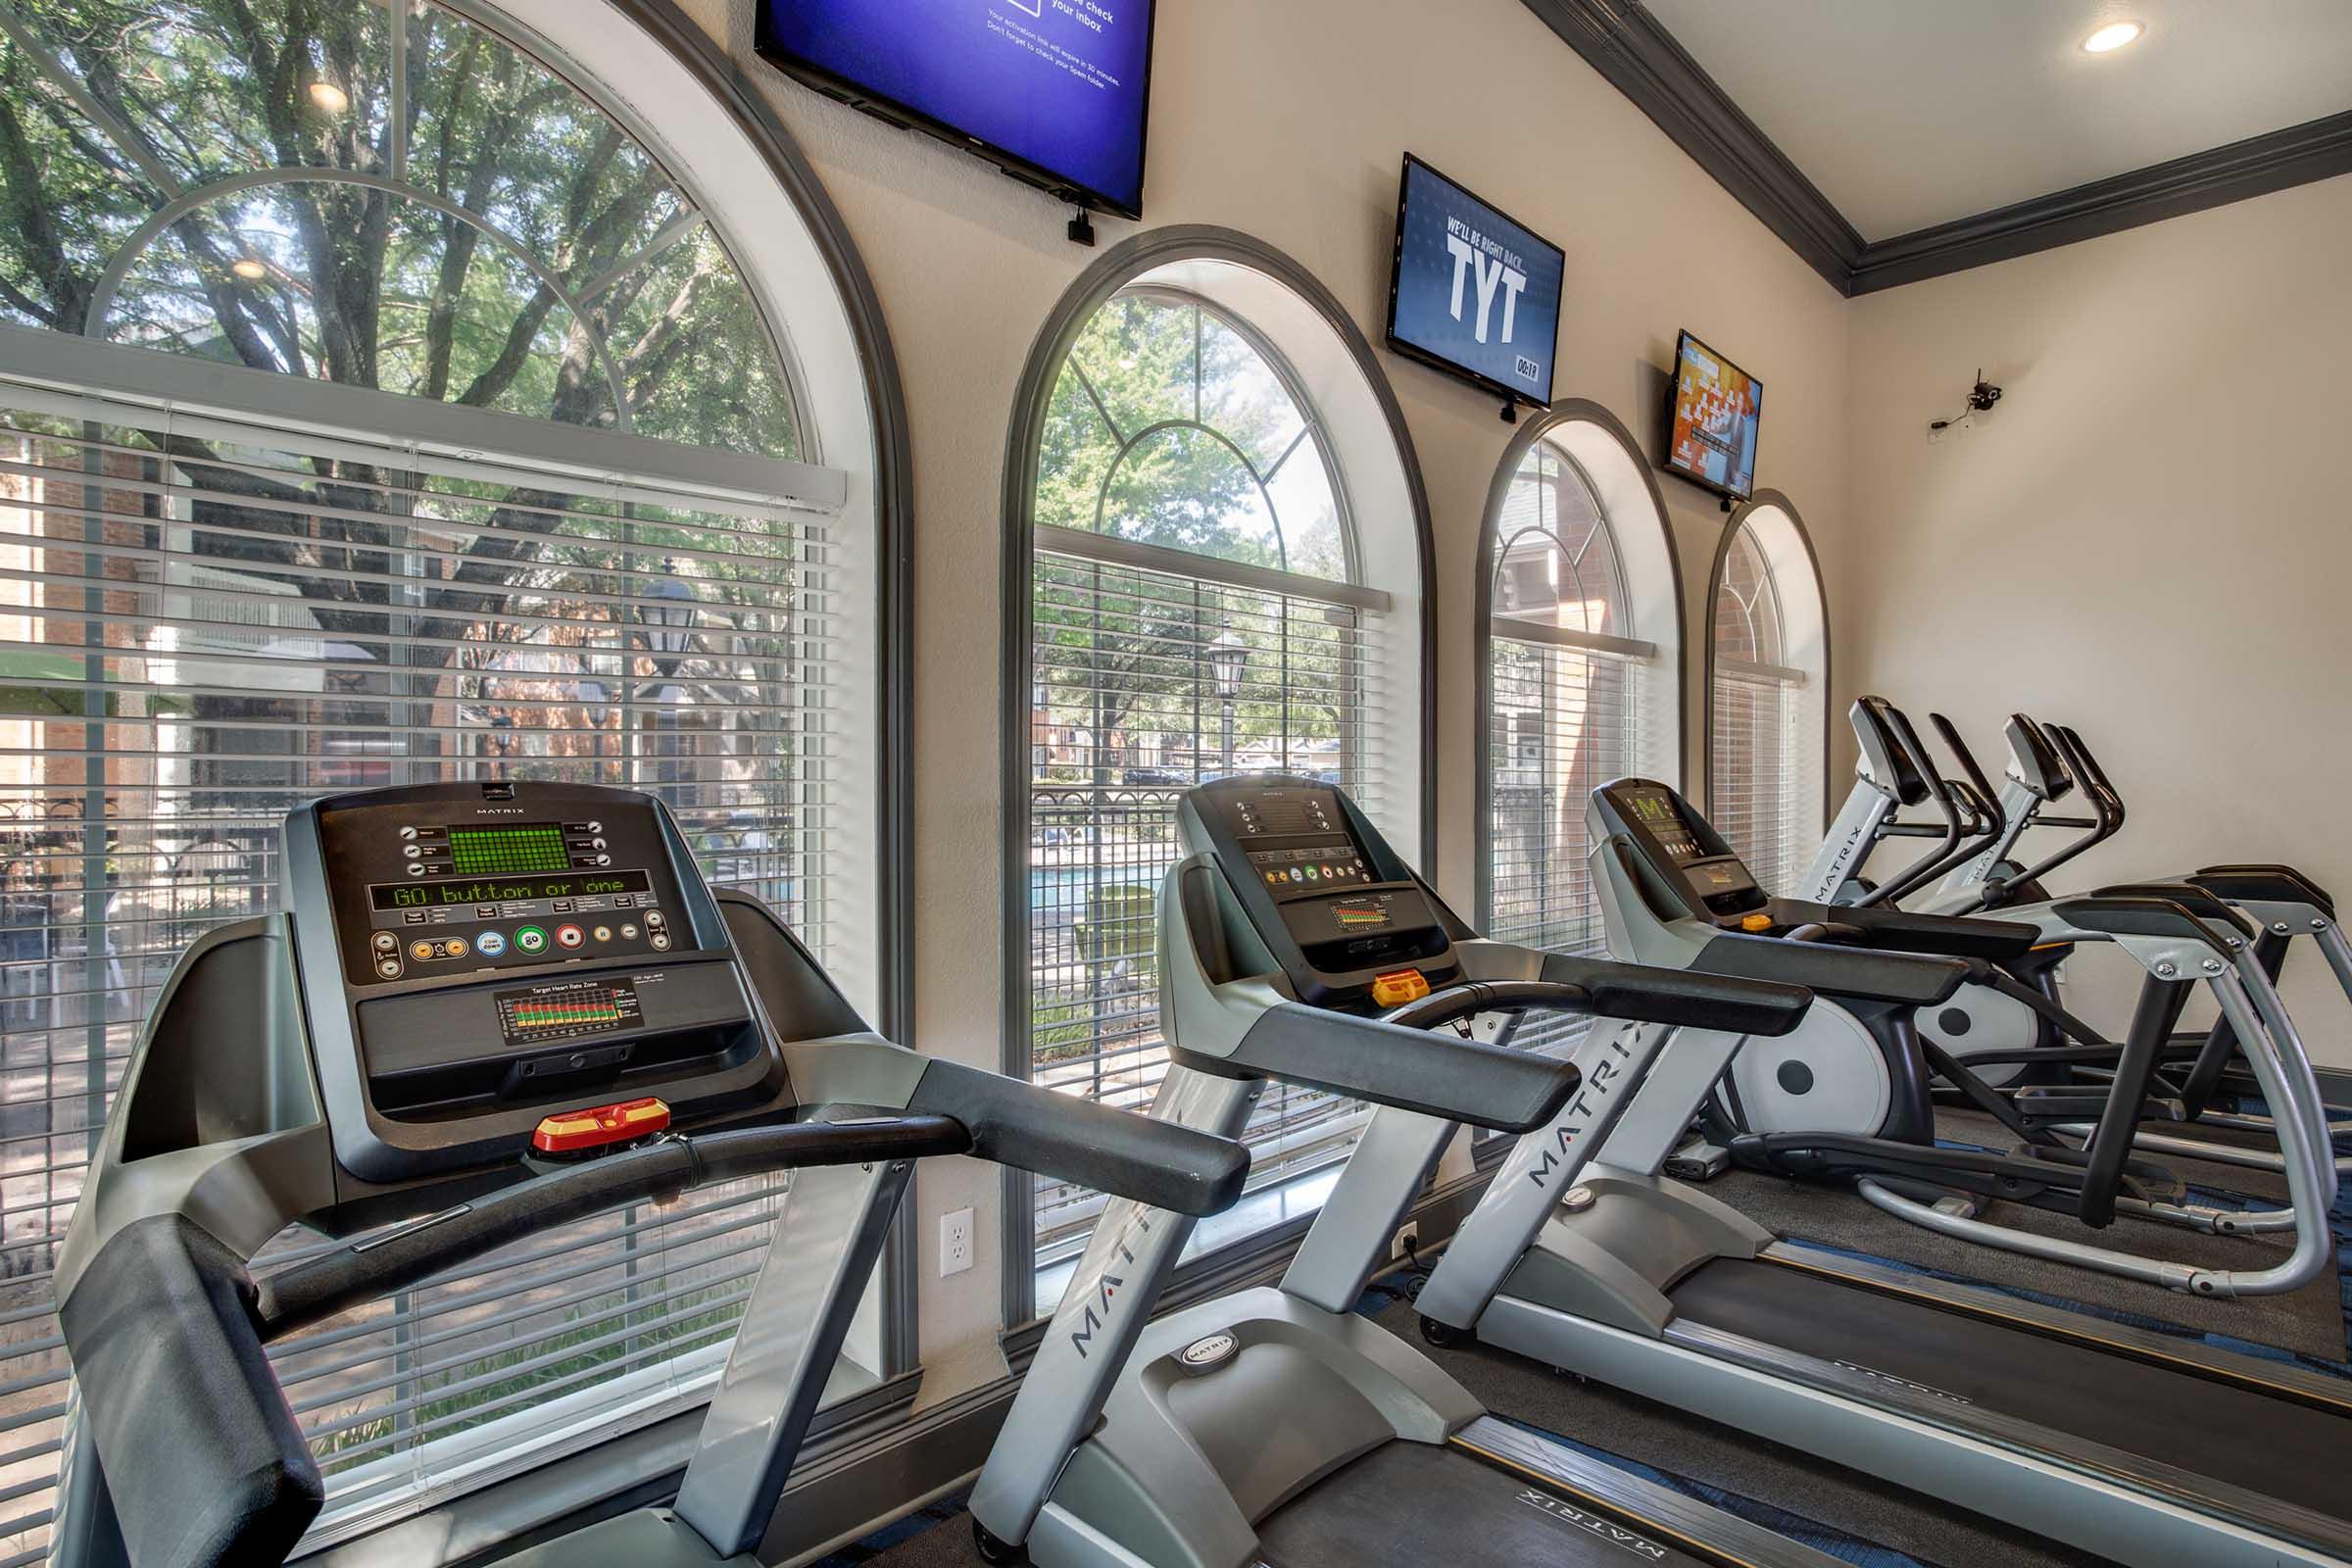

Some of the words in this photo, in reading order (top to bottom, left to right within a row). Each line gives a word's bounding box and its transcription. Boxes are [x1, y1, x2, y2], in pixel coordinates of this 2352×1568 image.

[1052, 0, 1074, 17] your
[1076, 9, 1102, 33] inbox
[1086, 1, 1113, 24] check
[988, 9, 1004, 21] Your
[1004, 19, 1037, 40] activation
[1061, 50, 1080, 65] expire
[1005, 30, 1026, 47] forget
[1027, 41, 1035, 52] to
[1035, 47, 1054, 63] check
[1054, 59, 1069, 71] your
[1447, 215, 1470, 241] WE'LL
[1470, 229, 1481, 247] BE
[1481, 237, 1503, 261] RIGHT
[1447, 232, 1527, 344] TYT
[1815, 826, 1861, 902] MATRIX
[393, 887, 426, 906] GO
[441, 883, 533, 904] button
[546, 884, 571, 898] or
[585, 880, 625, 896] one
[524, 935, 539, 946] go
[1529, 1020, 1650, 1188] MATRIX
[1190, 1336, 1231, 1359] MATRIX
[1520, 1489, 1665, 1558] MATRIX
